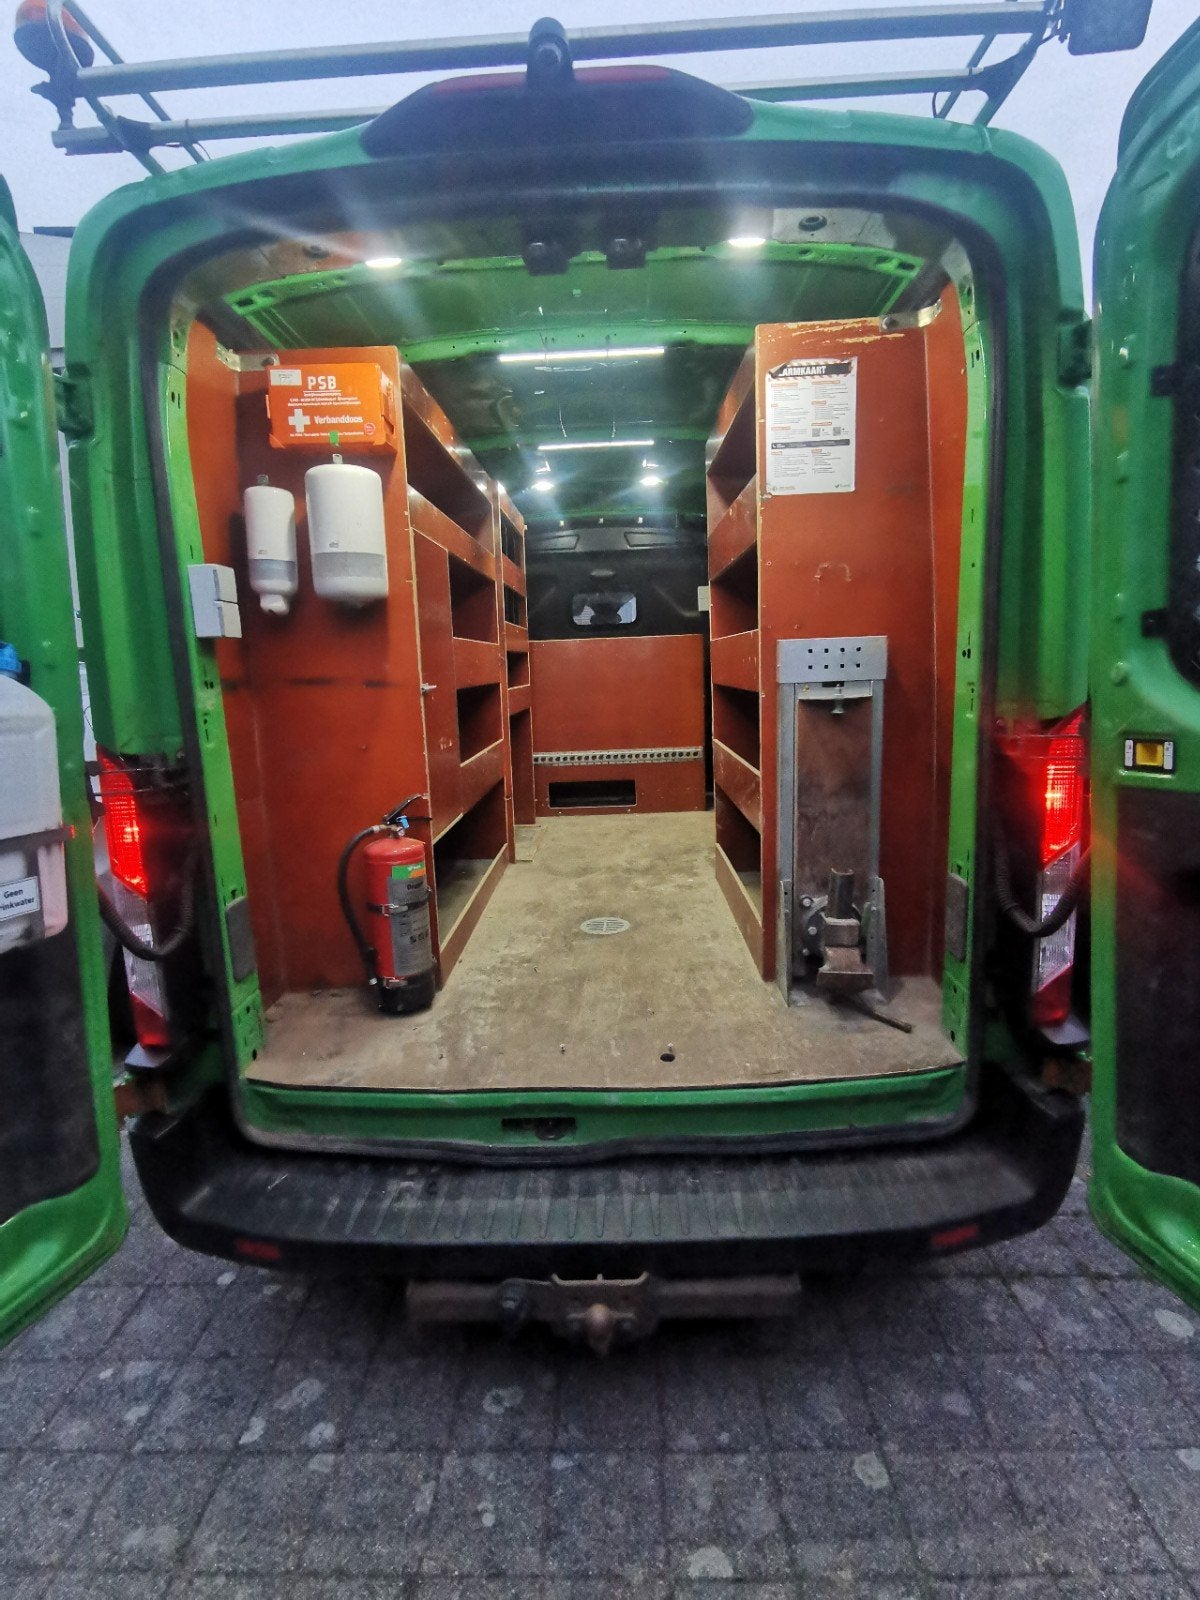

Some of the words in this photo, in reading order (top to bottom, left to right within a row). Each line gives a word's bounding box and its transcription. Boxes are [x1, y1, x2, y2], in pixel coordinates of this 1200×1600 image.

[307, 375, 337, 390] PSB
[314, 414, 363, 425] Verbanddoos
[3, 889, 24, 899] Geen
